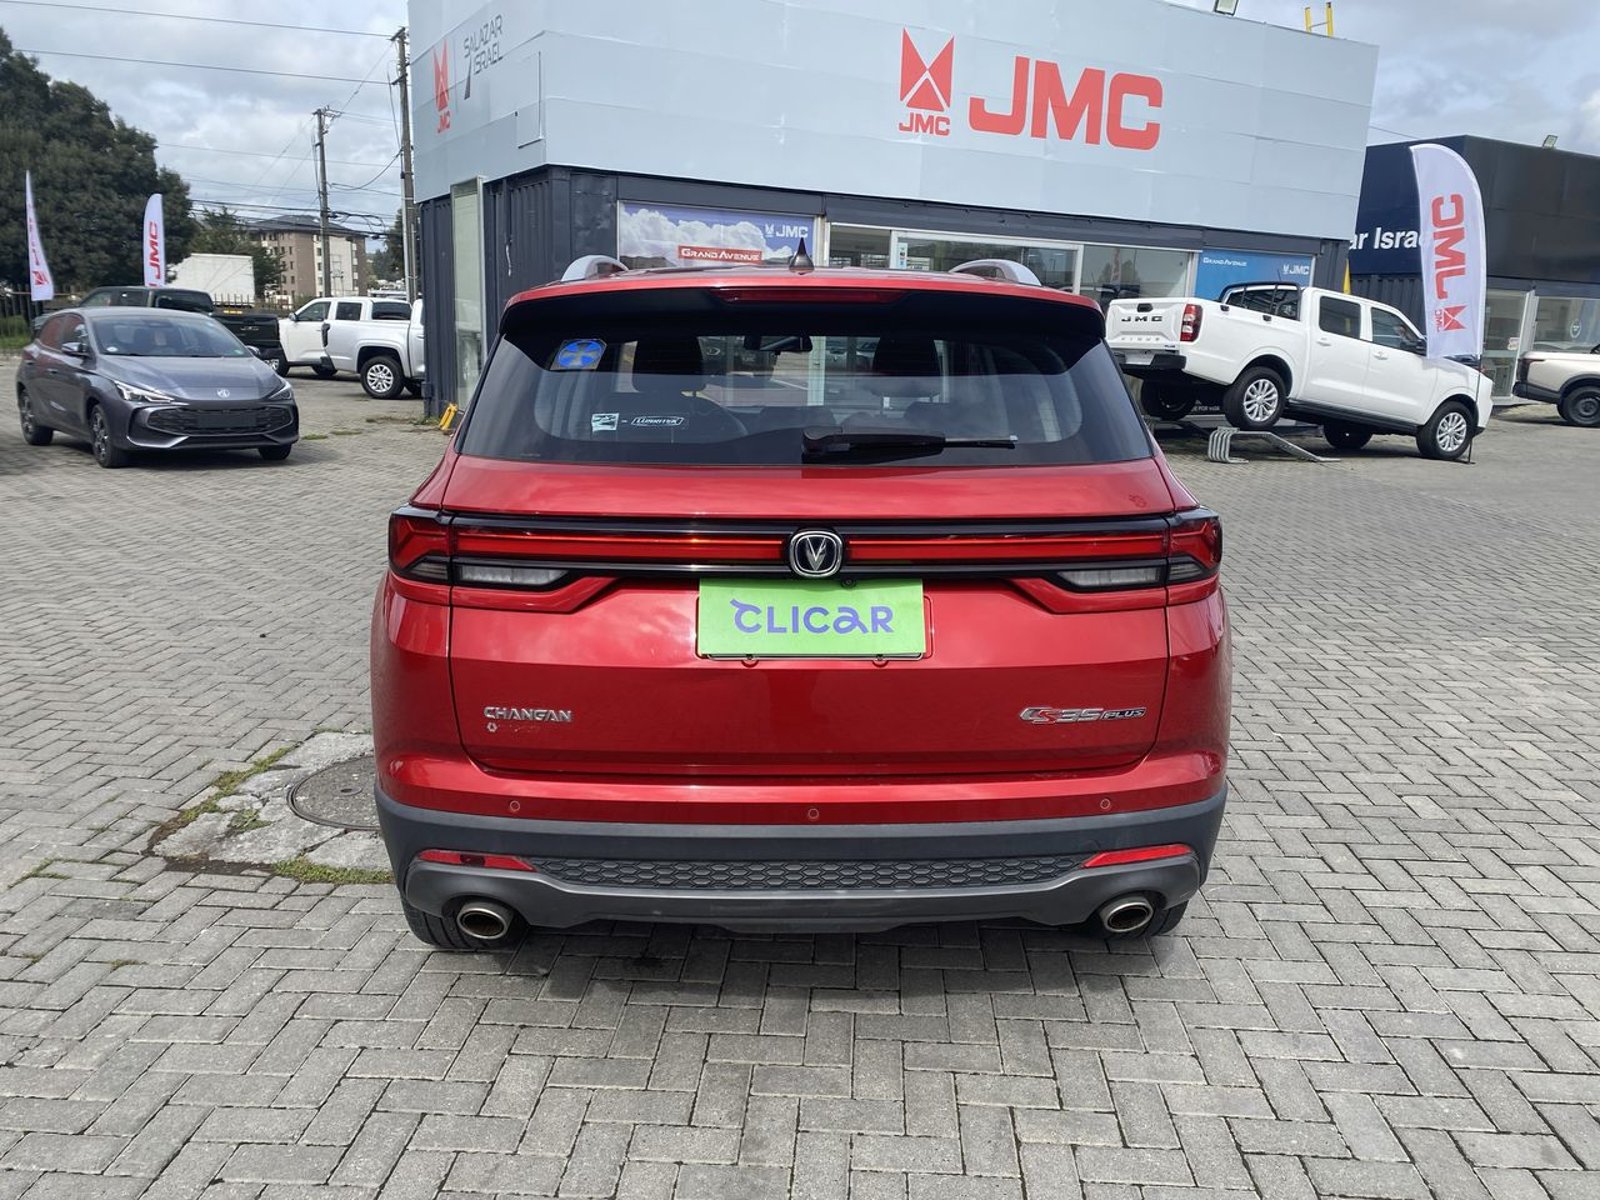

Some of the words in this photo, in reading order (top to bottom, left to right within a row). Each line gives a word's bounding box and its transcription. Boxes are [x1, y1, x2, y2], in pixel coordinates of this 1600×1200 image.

[463, 14, 503, 59] SALAZAR
[473, 42, 504, 75] ISRAEL
[969, 55, 1163, 151] JMC
[899, 112, 950, 136] JMC
[775, 224, 809, 239] JMC
[681, 247, 717, 259] GRAND
[718, 250, 760, 261] AVENUE
[1431, 194, 1467, 300] JMC
[1289, 264, 1309, 275] JMC
[483, 706, 572, 723] CHANGAN
[1019, 706, 1104, 726] CS35
[1102, 708, 1146, 720] PLUS
